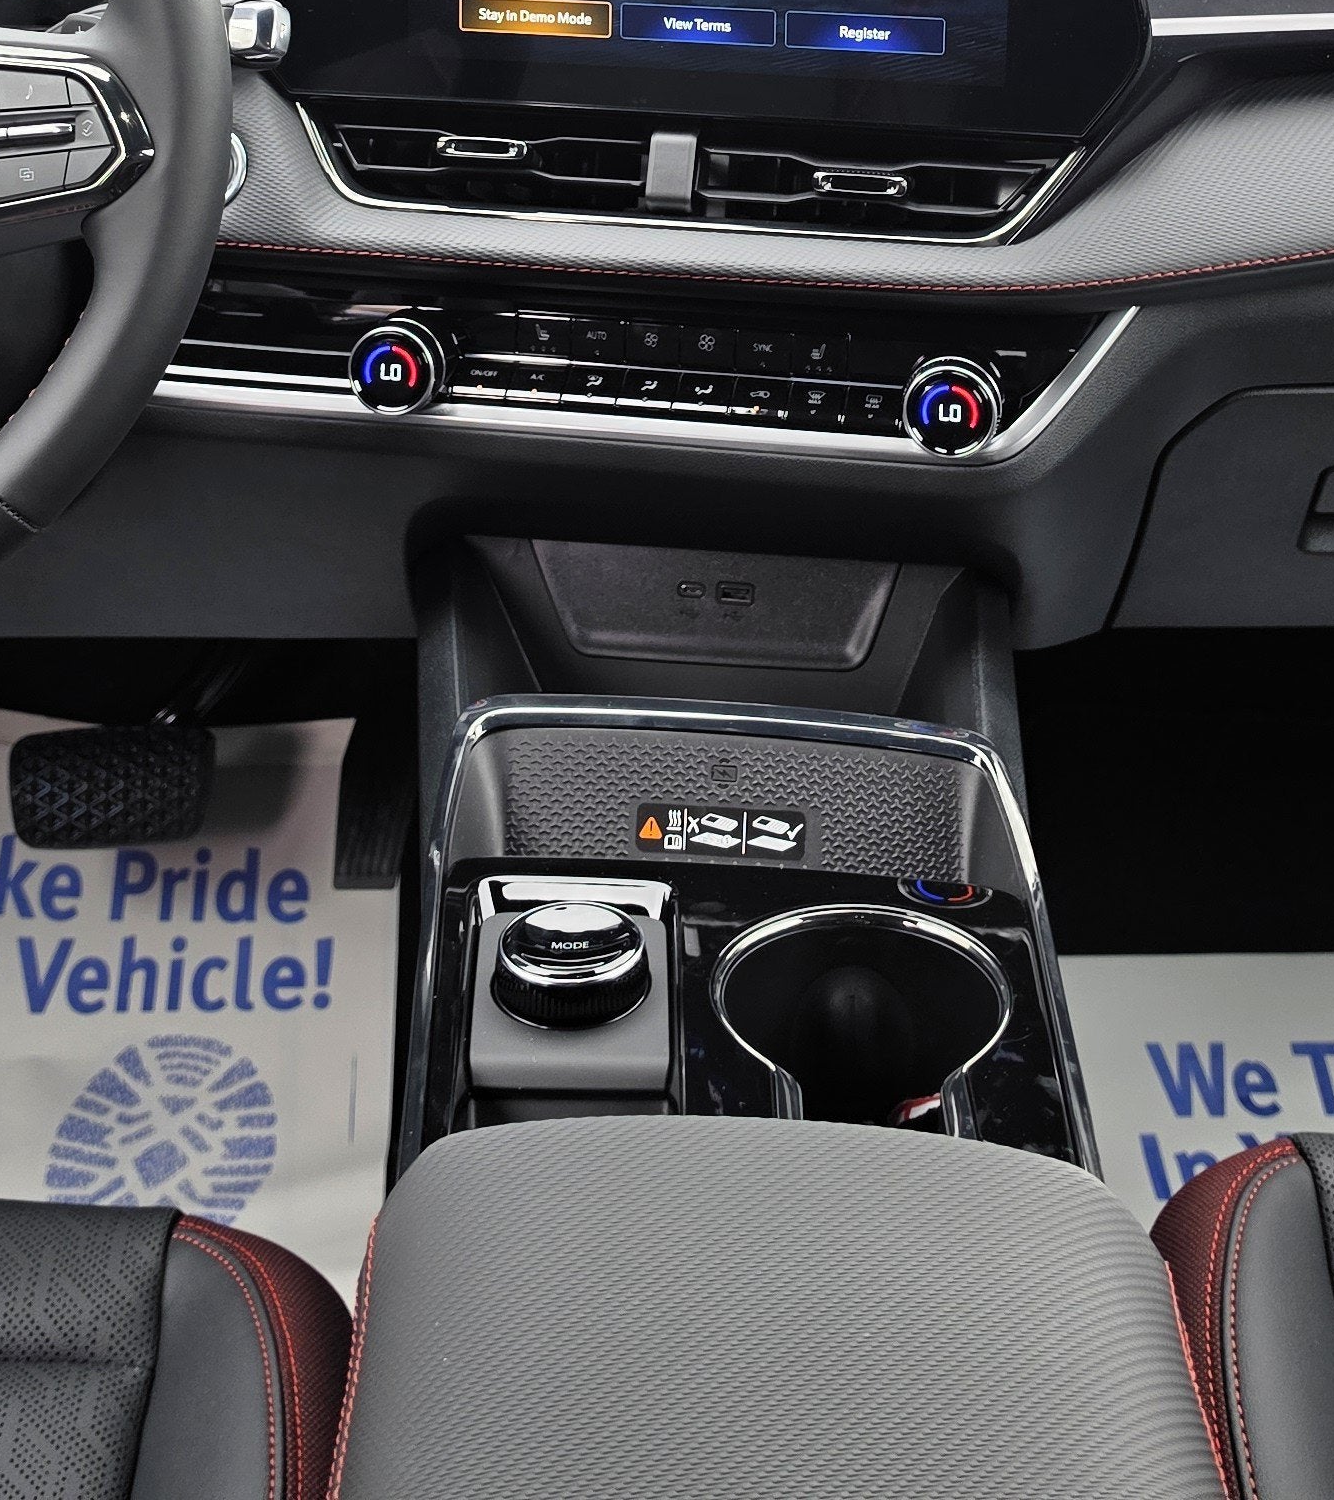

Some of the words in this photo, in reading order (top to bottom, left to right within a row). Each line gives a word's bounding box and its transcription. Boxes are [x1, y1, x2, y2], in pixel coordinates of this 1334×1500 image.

[478, 7, 504, 25] Stay
[506, 8, 518, 22] in
[520, 9, 555, 25] Demo
[557, 11, 592, 27] Mode
[663, 16, 692, 31] View
[693, 17, 731, 33] Terms
[839, 25, 891, 43] Register
[586, 331, 607, 341] AUTO
[753, 343, 773, 353] SYNC
[379, 364, 401, 381] LO
[470, 369, 498, 378] ON/OFF
[530, 373, 544, 381] A/C
[938, 403, 962, 422] LO
[110, 848, 310, 924] Pride
[551, 941, 589, 950] MODE
[18, 937, 334, 1014] Vehicle!
[1145, 1041, 1278, 1118] We
